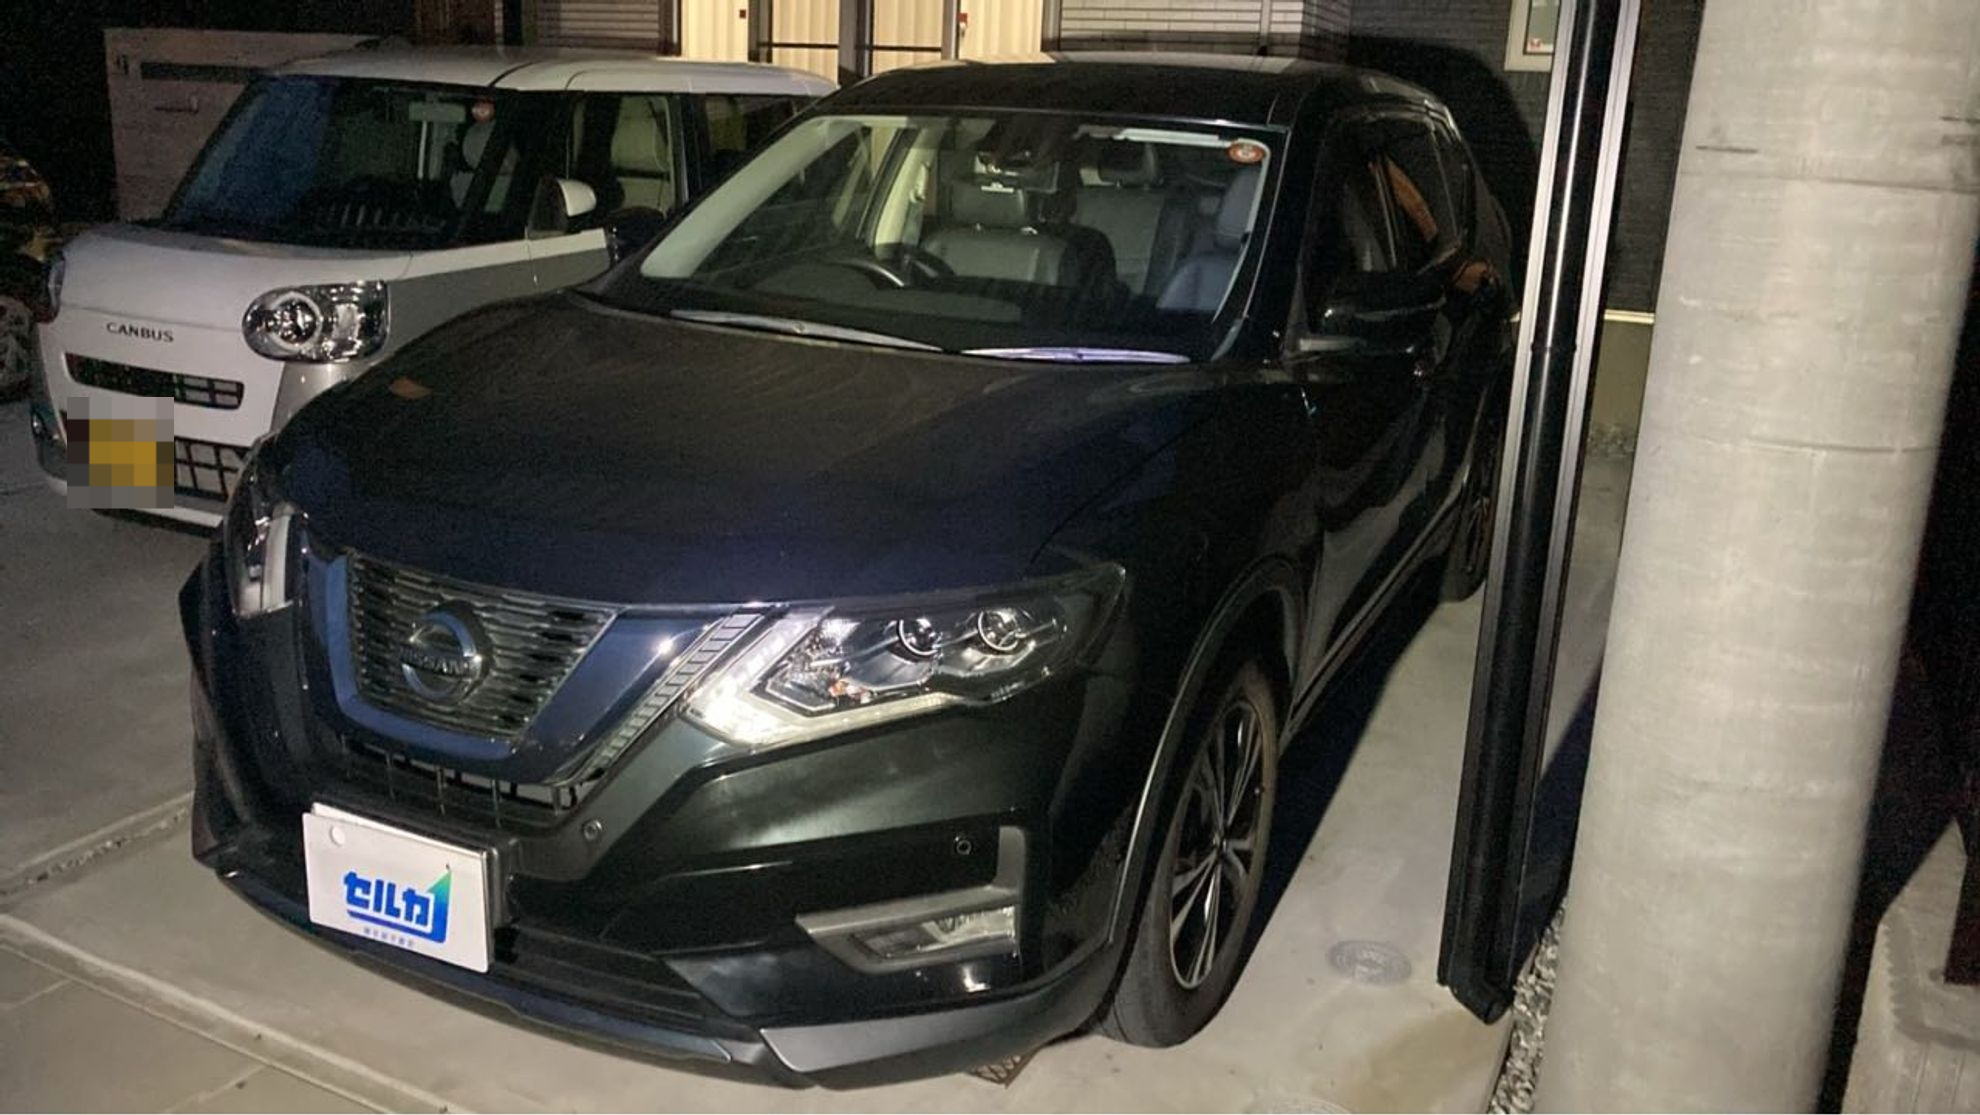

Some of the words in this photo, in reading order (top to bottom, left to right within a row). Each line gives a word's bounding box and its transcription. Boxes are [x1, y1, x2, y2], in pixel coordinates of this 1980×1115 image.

[106, 321, 174, 342] CANBUS
[344, 871, 430, 927] セルカ
